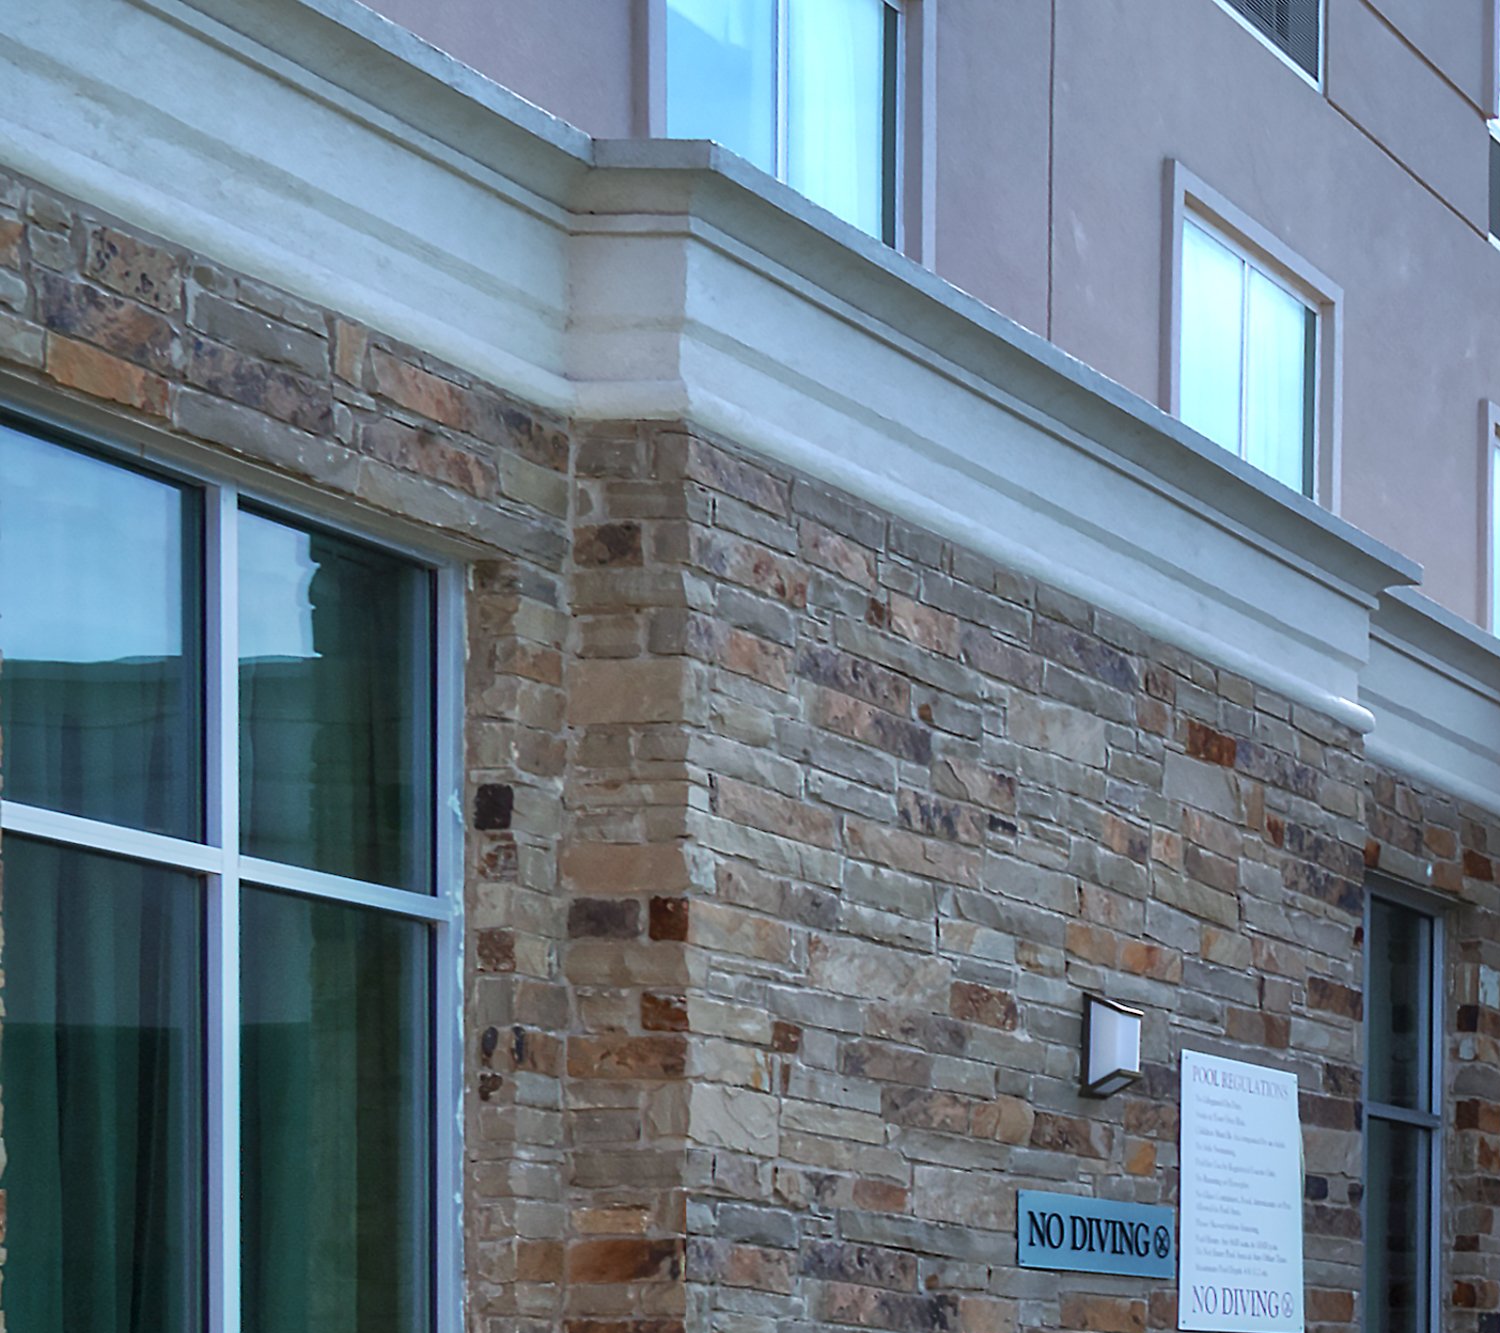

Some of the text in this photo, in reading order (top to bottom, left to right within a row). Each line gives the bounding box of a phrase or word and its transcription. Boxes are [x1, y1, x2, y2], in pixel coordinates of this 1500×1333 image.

[1192, 1065, 1289, 1098] POOL REGULATIONS
[1028, 1210, 1150, 1257] NO DIVING
[1192, 1285, 1279, 1318] NO DIVING
